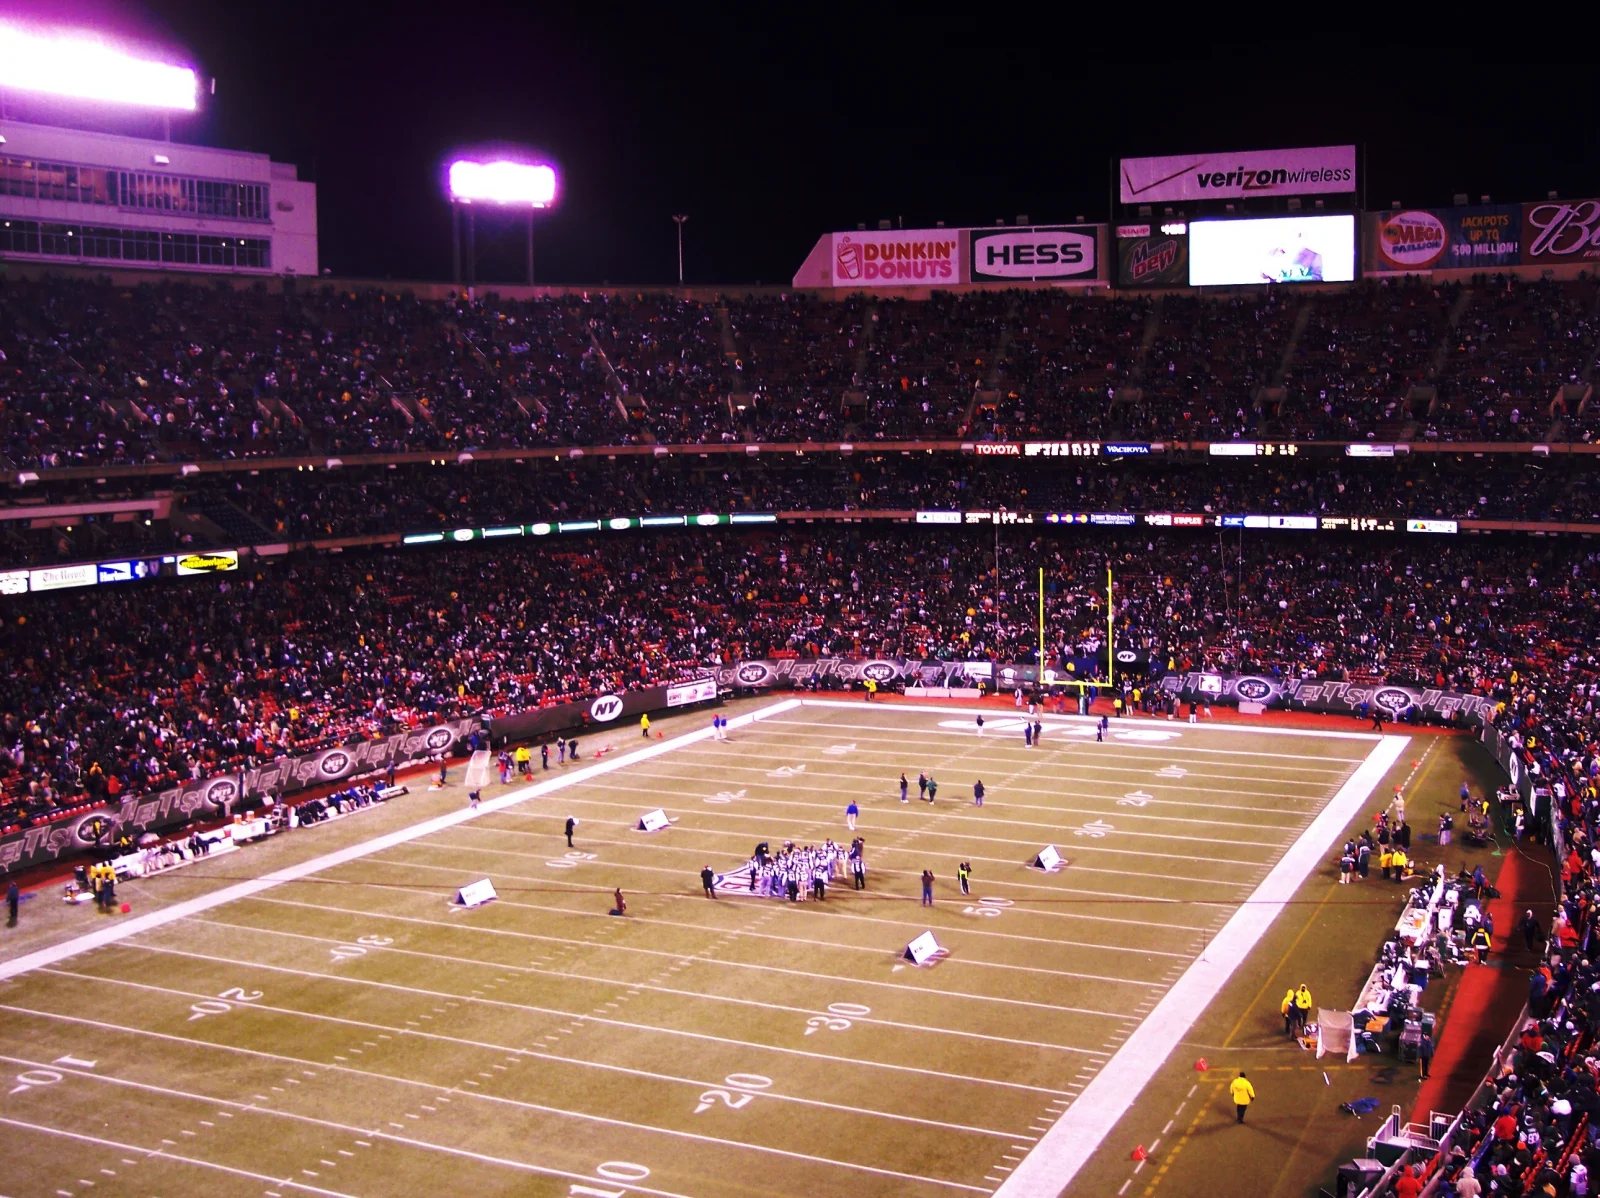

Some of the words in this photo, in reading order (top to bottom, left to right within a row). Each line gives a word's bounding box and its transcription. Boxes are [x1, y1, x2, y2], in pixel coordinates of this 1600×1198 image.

[1460, 214, 1509, 228] JACKPOTS
[1395, 224, 1442, 245] MEGA
[1469, 229, 1484, 241] UP
[1486, 228, 1499, 240] TO
[864, 241, 956, 261] DUNKIN'
[987, 243, 1084, 266] HESS
[864, 259, 953, 280] DONUTS
[976, 445, 1020, 455] TOYOTA
[1106, 445, 1149, 453] WACHOVIA
[594, 700, 619, 716] NY
[963, 897, 1015, 917] 50
[191, 987, 263, 1014] 20
[806, 1003, 870, 1031] 30
[16, 1054, 98, 1085] 10
[700, 1073, 773, 1109] 20
